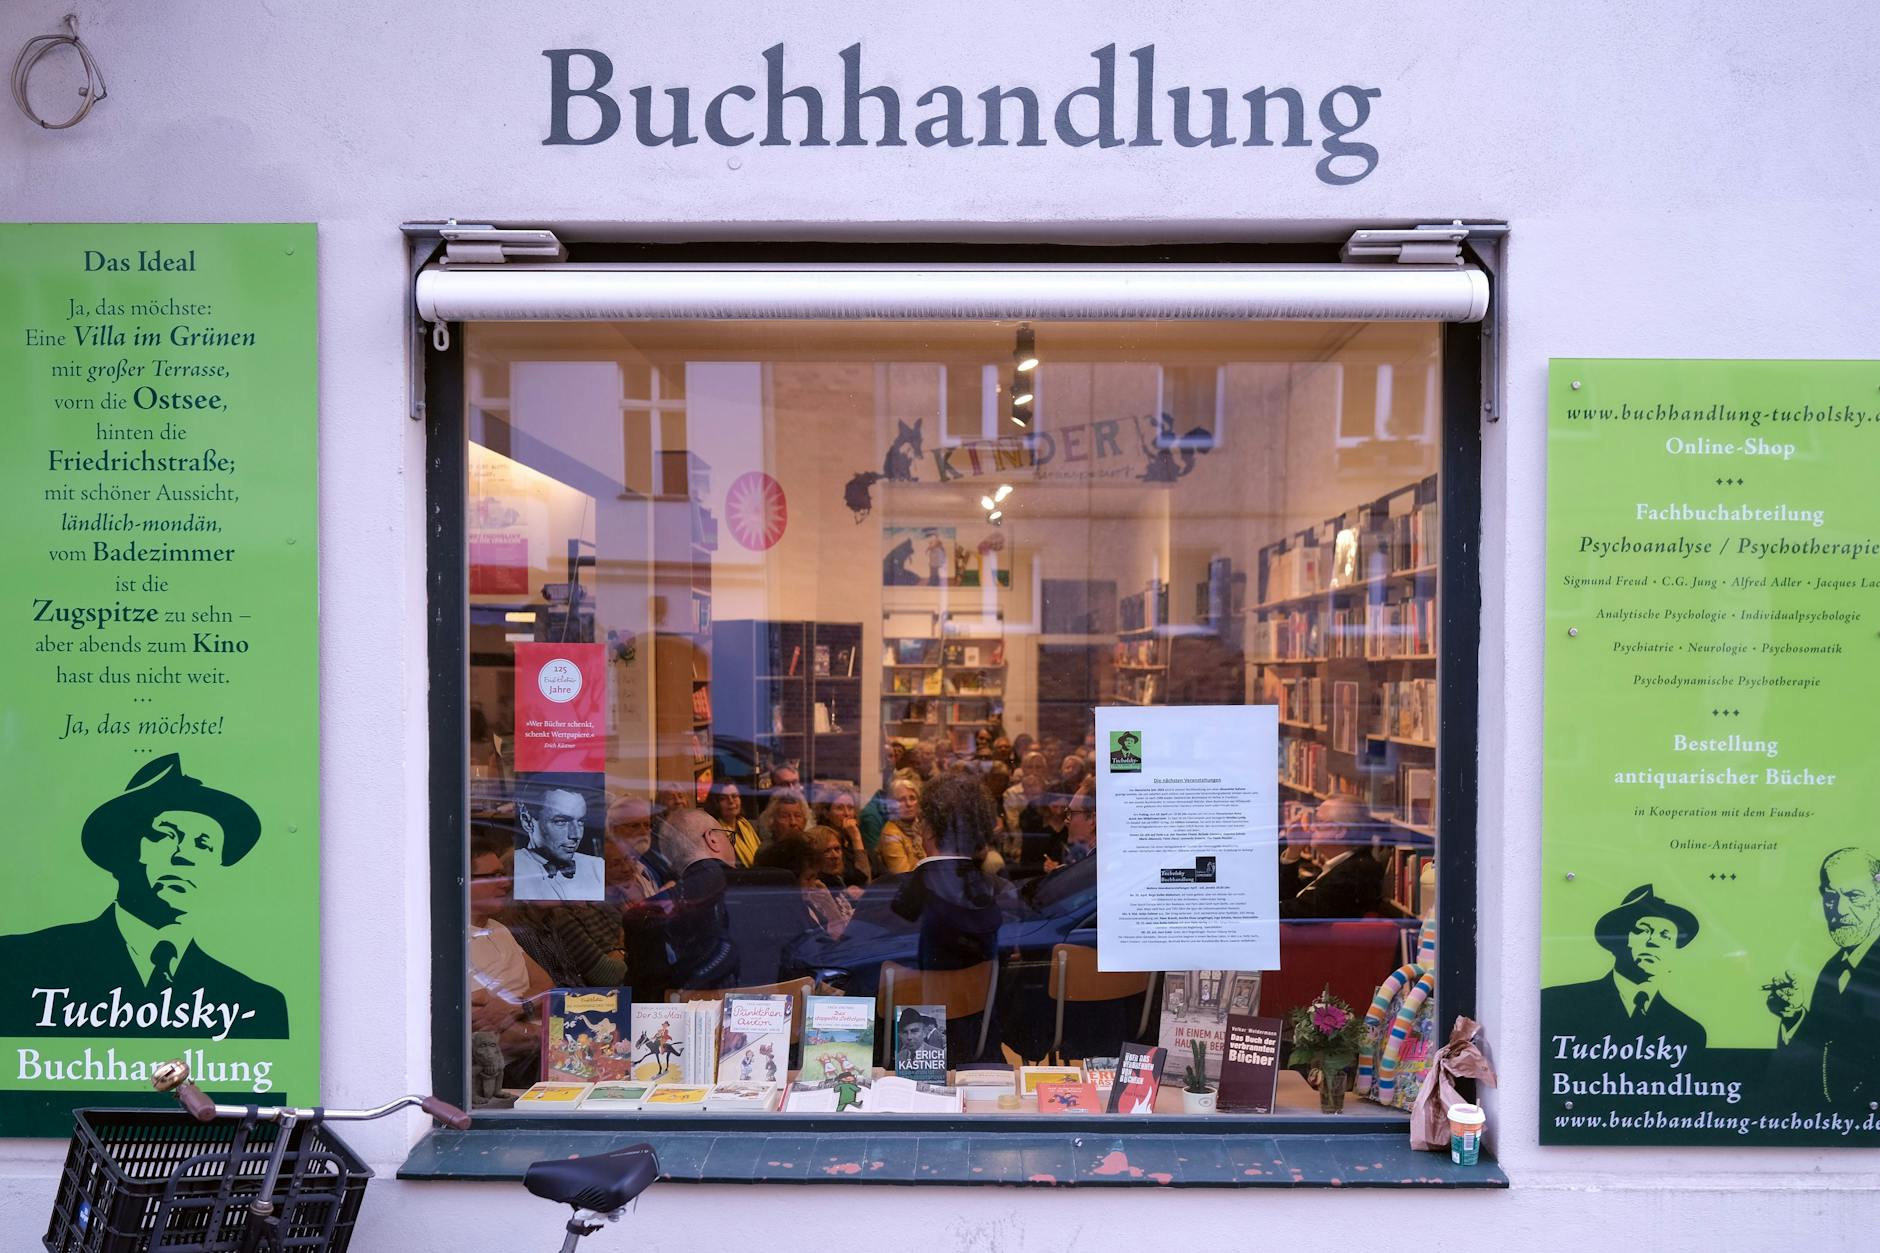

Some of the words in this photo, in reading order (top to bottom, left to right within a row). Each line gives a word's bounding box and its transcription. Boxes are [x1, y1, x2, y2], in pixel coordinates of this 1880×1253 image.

[541, 42, 1383, 186] Buchhandlung
[84, 250, 129, 272] Das
[138, 250, 196, 272] Ideal
[67, 298, 90, 320] Ja,
[95, 298, 125, 315] das
[131, 299, 212, 315] möchste:
[26, 329, 66, 346] Eine
[73, 325, 126, 346] Villa
[134, 326, 161, 346] im
[170, 326, 256, 346] Grünen
[52, 361, 82, 377] mit
[86, 360, 144, 382] großer
[152, 360, 229, 379] Terrasse,
[55, 396, 94, 410] vorn
[101, 392, 127, 410] die
[134, 386, 227, 411] Ostsee,
[96, 423, 153, 440] hinten
[160, 423, 187, 440] die
[932, 419, 1123, 482] KINDER
[1666, 437, 1796, 460] Online-Shop
[48, 448, 235, 475] Friedrichstraße;
[45, 485, 75, 501] mit
[80, 484, 151, 501] schöner
[155, 484, 239, 503] Aussicht,
[61, 513, 222, 533] ländlich-mondän,
[1636, 503, 1824, 526] Fachbuchabteilung
[49, 548, 86, 561] vom
[93, 541, 236, 562] Badezimmer
[1579, 536, 1712, 560] Psychoanalyse
[1737, 538, 1880, 560] Psychotherapie
[115, 576, 136, 592] ist
[142, 575, 169, 592] die
[1563, 575, 1611, 587] Sigmund
[1615, 575, 1648, 586] Freud
[1662, 576, 1688, 587] C.G.
[1691, 576, 1718, 590] Jung
[1730, 576, 1767, 590] Alfred
[1771, 576, 1802, 587] Adler
[1813, 578, 1856, 592] Jacques
[32, 598, 158, 629] Zugspitze
[164, 610, 186, 623] zu
[192, 605, 233, 622] sehn
[1596, 609, 1660, 621] Analytische
[1663, 609, 1727, 622] Psychologie
[1739, 610, 1862, 622] Individualpsychologie
[35, 635, 74, 652] aber
[79, 635, 141, 653] abends
[147, 639, 186, 653] zum
[193, 633, 249, 654] Kino
[1613, 642, 1674, 654] Psychiatrie
[1688, 642, 1748, 655] Neurologie
[1761, 643, 1843, 655] Psychosomatik
[56, 666, 92, 684] hast
[100, 666, 130, 684] dus
[136, 666, 181, 684] nicht
[188, 667, 229, 684] weit.
[1633, 675, 1734, 688] Psychodynamische
[1738, 675, 1821, 689] Psychotherapie
[549, 686, 571, 695] Jahre
[59, 713, 89, 739] Ja,
[97, 713, 130, 735] das
[138, 713, 223, 735] möchste!
[1674, 735, 1778, 758] Bestellung
[1614, 768, 1758, 789] antiquarischer
[1766, 768, 1836, 785] Bücher
[1634, 807, 1646, 817] in
[1649, 807, 1717, 820] Kooperation
[1721, 807, 1739, 818] mit
[1743, 807, 1765, 818] dem
[1770, 808, 1815, 819] Fundus-
[1669, 839, 1778, 852] Online-Antiquariat
[31, 986, 256, 1042] Tucholsky-
[1175, 1027, 1184, 1036] IN
[1186, 1028, 1211, 1038] EINEM
[1245, 1035, 1262, 1044] Buch
[1263, 1037, 1276, 1045] der
[1248, 1028, 1277, 1036] Weidermann
[916, 1050, 944, 1059] ERICH
[1228, 1049, 1275, 1067] Bücher
[1230, 1042, 1276, 1053] verbrannten
[1552, 1034, 1688, 1068] Tucholsky
[899, 1059, 945, 1070] KÄSTNER
[1552, 1072, 1742, 1103] Buchhandlung
